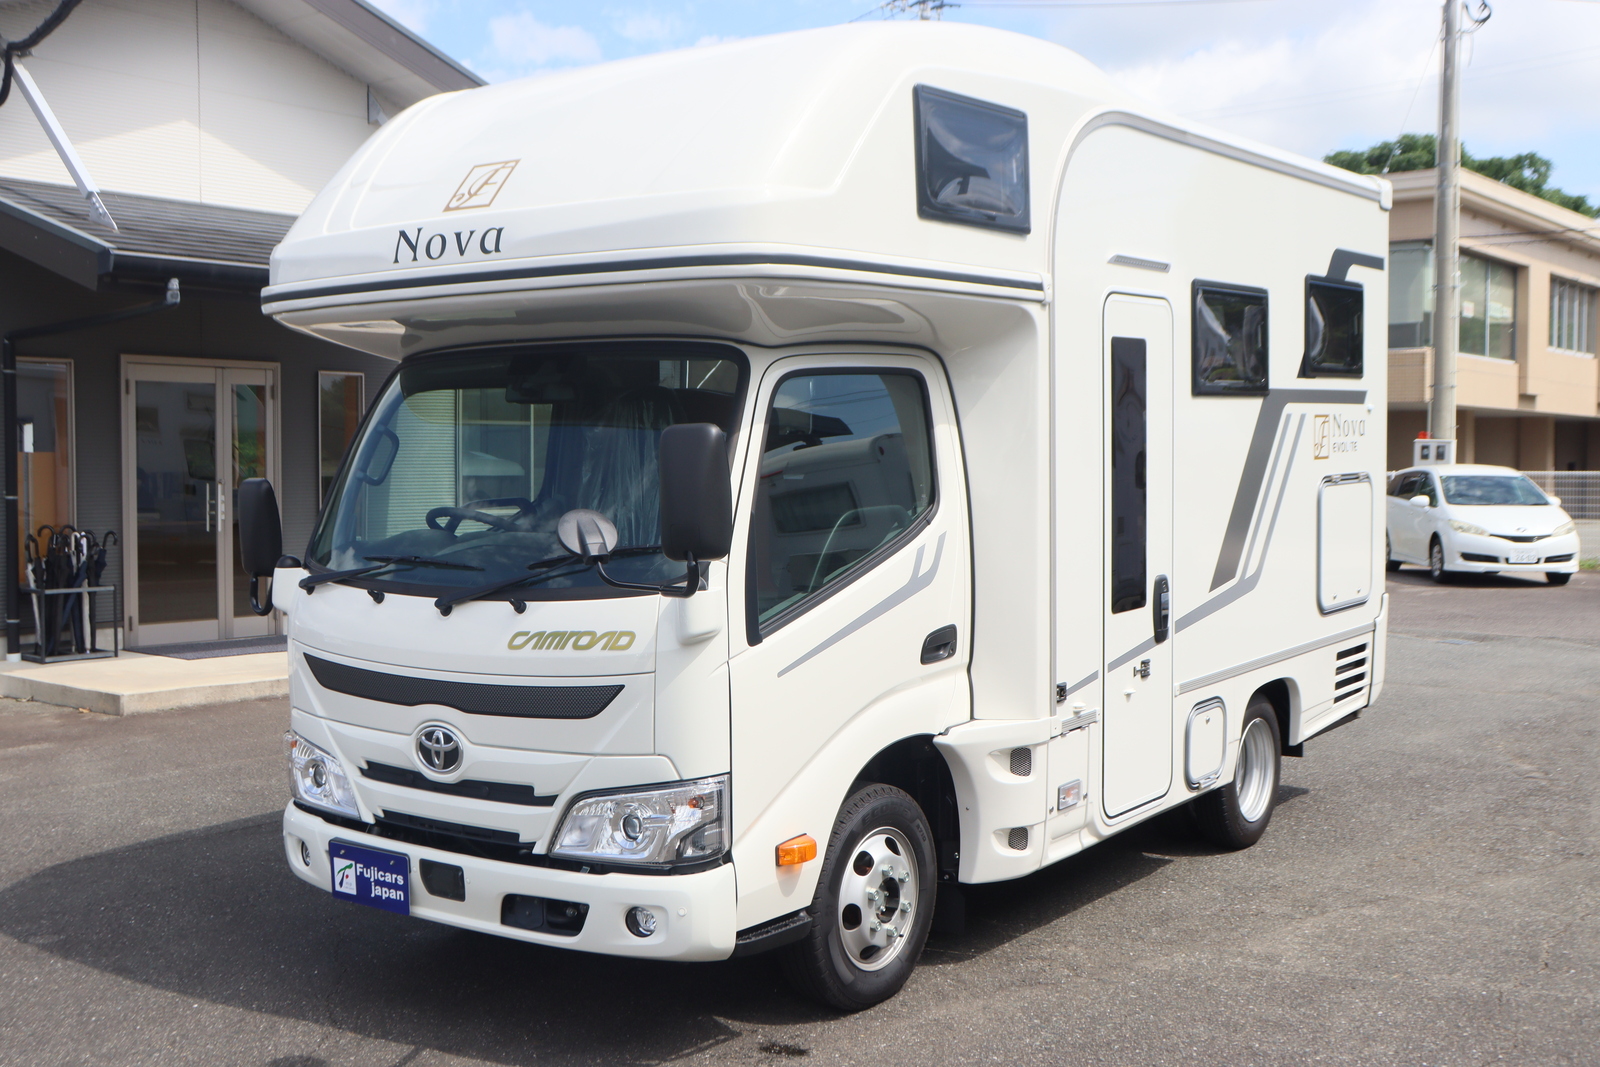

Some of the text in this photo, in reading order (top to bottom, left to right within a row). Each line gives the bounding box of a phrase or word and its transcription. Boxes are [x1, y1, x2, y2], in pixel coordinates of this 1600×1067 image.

[393, 226, 505, 264] Nova
[1332, 413, 1366, 437] Nova
[356, 863, 404, 886] Fujicars
[370, 882, 404, 901] japan
